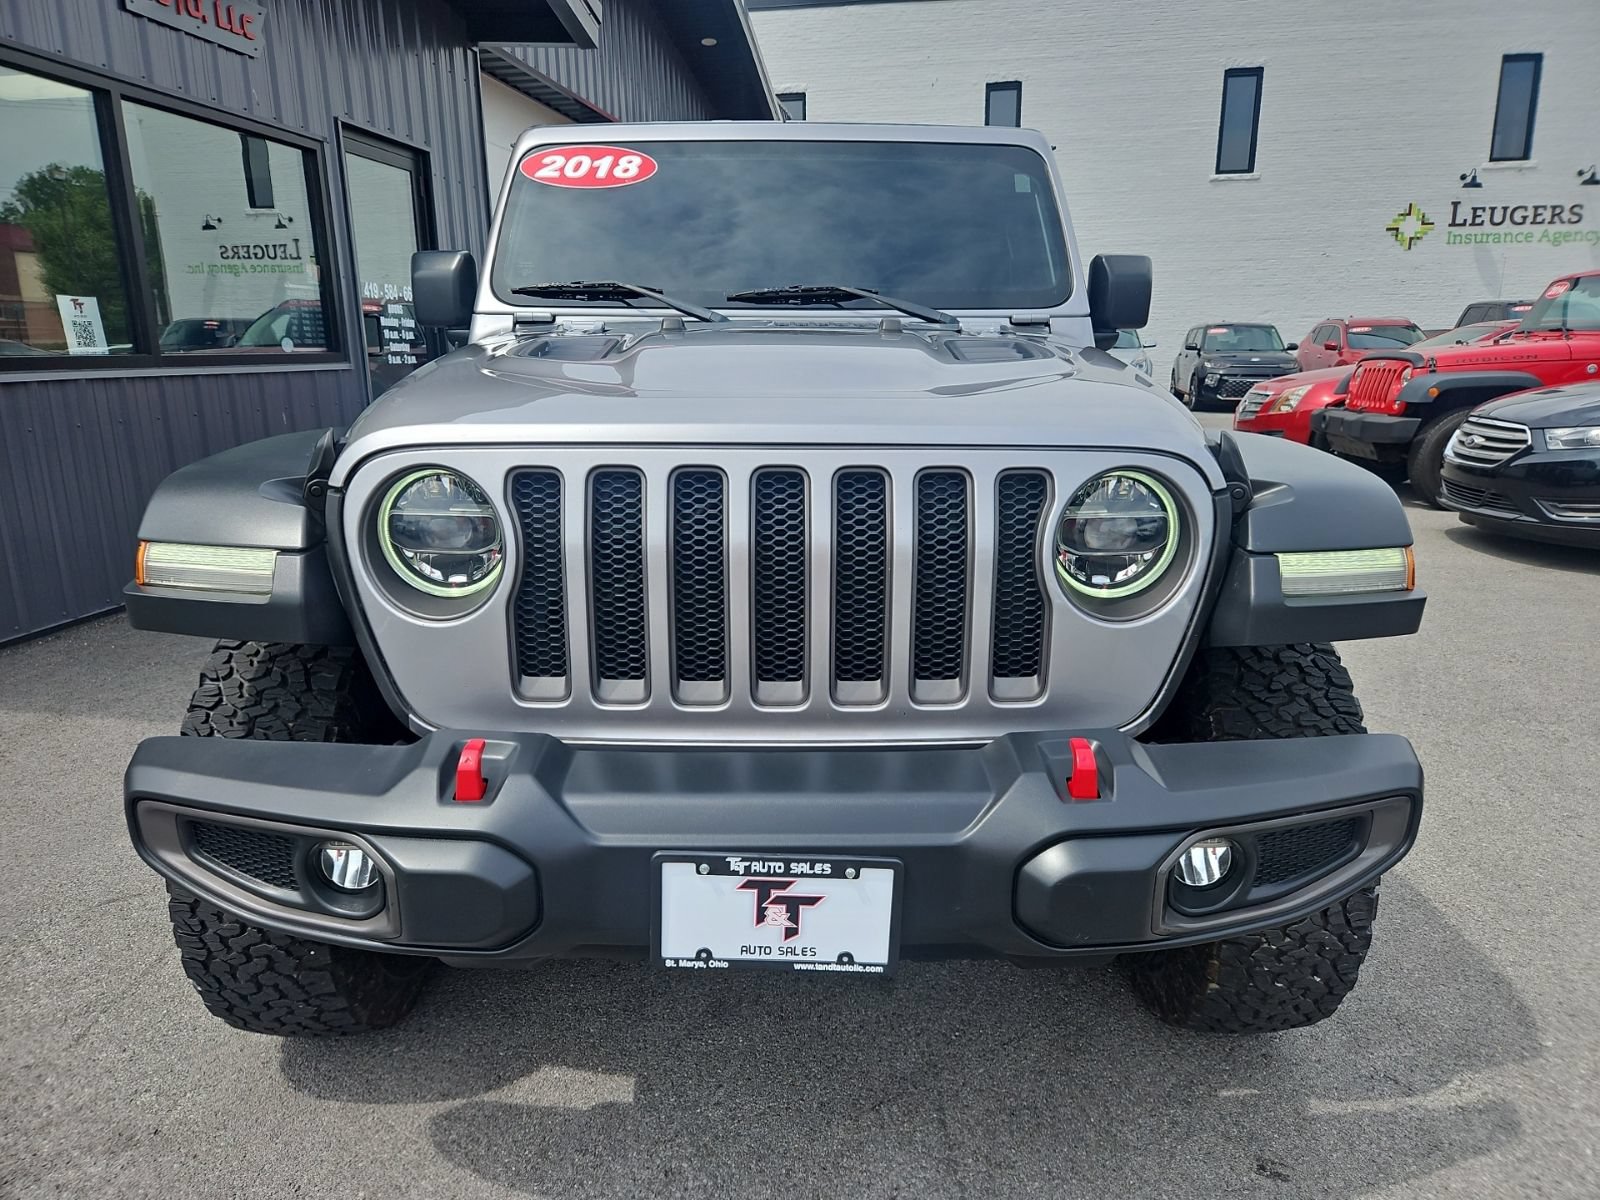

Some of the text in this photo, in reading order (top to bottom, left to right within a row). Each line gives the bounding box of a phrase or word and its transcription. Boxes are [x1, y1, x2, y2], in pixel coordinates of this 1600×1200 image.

[215, 0, 256, 40] LLC
[534, 154, 643, 179] 2018
[1448, 200, 1584, 228] LEUGERS
[1446, 228, 1600, 247] Insurance Agency
[363, 281, 379, 299] 419
[751, 859, 785, 874] AUTO
[789, 861, 832, 875] SALES
[740, 943, 817, 957] AUTO SALES
[665, 959, 729, 970] St. Marys, Ohio
[793, 962, 884, 974] www.tandtautollc.com
